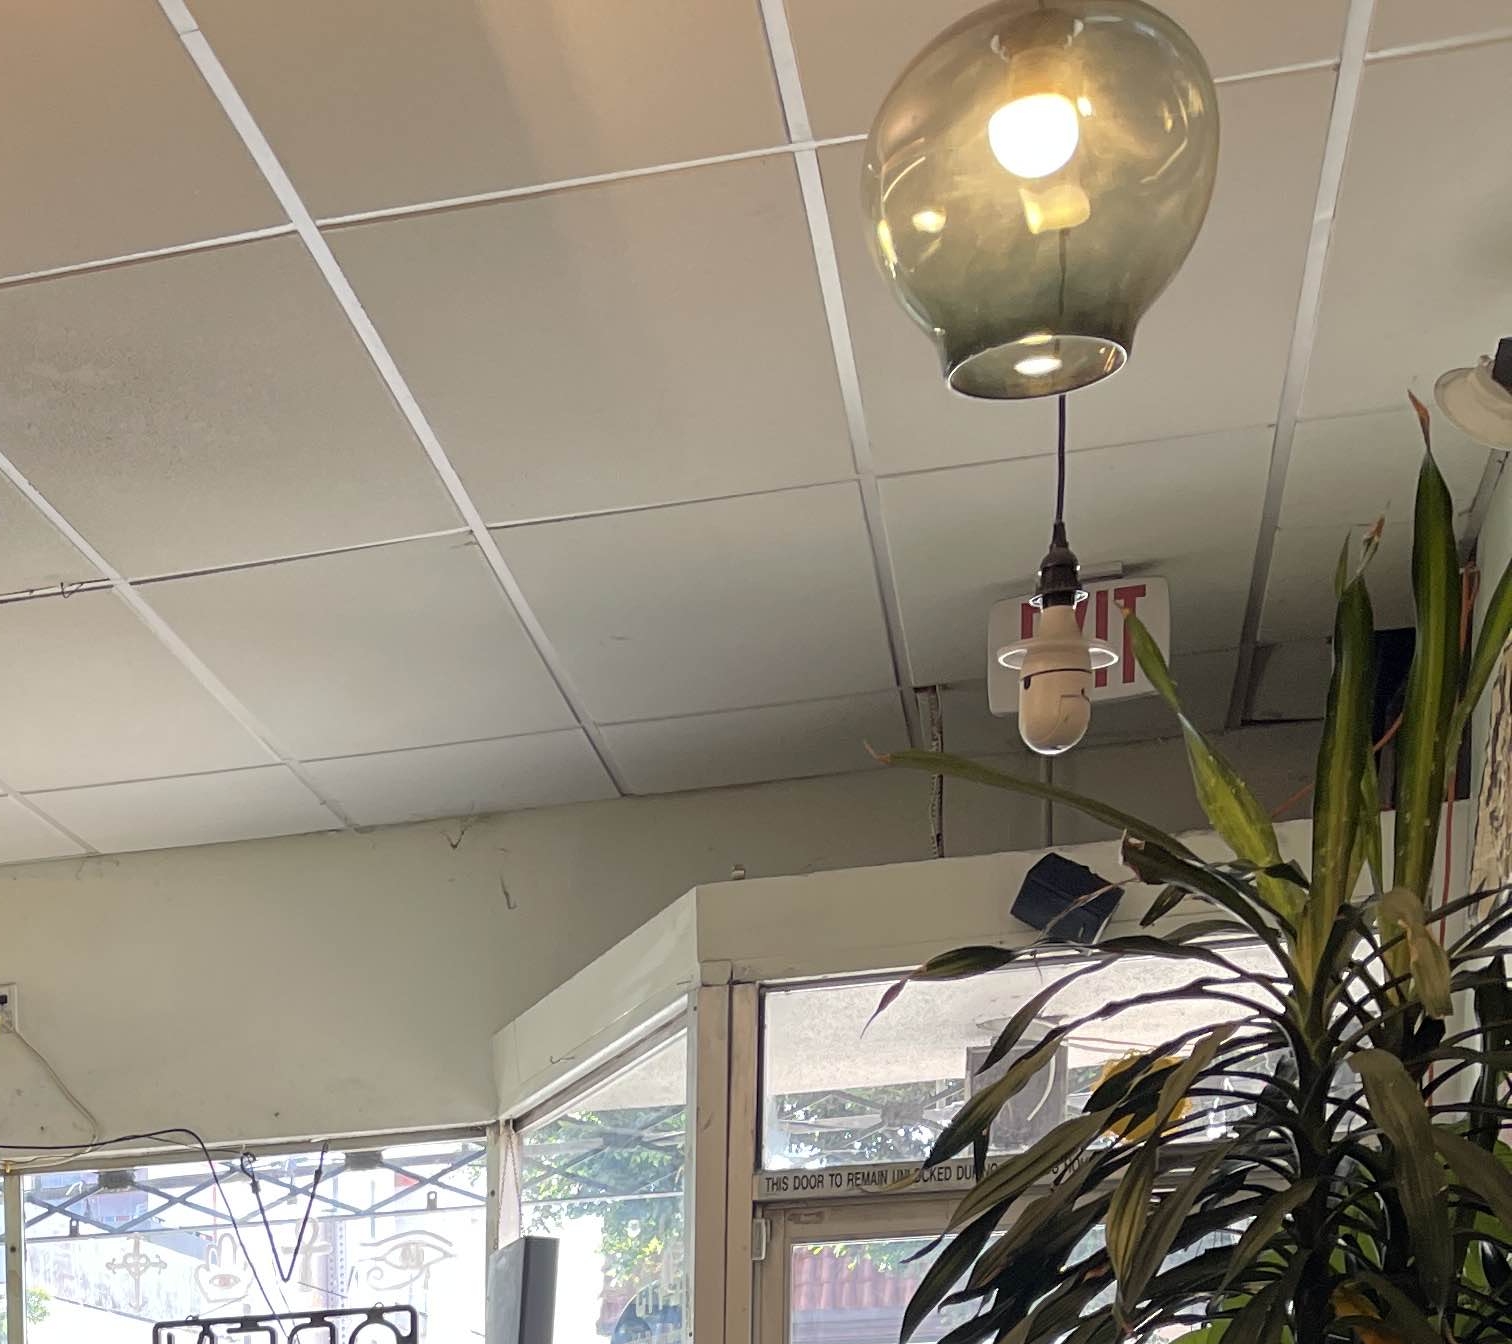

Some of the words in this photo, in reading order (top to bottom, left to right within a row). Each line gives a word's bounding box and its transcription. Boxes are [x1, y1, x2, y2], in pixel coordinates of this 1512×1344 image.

[765, 1176, 788, 1192] THIS
[794, 1174, 824, 1190] DOOR
[829, 1172, 843, 1187] TO
[847, 1170, 887, 1186] REMAIN
